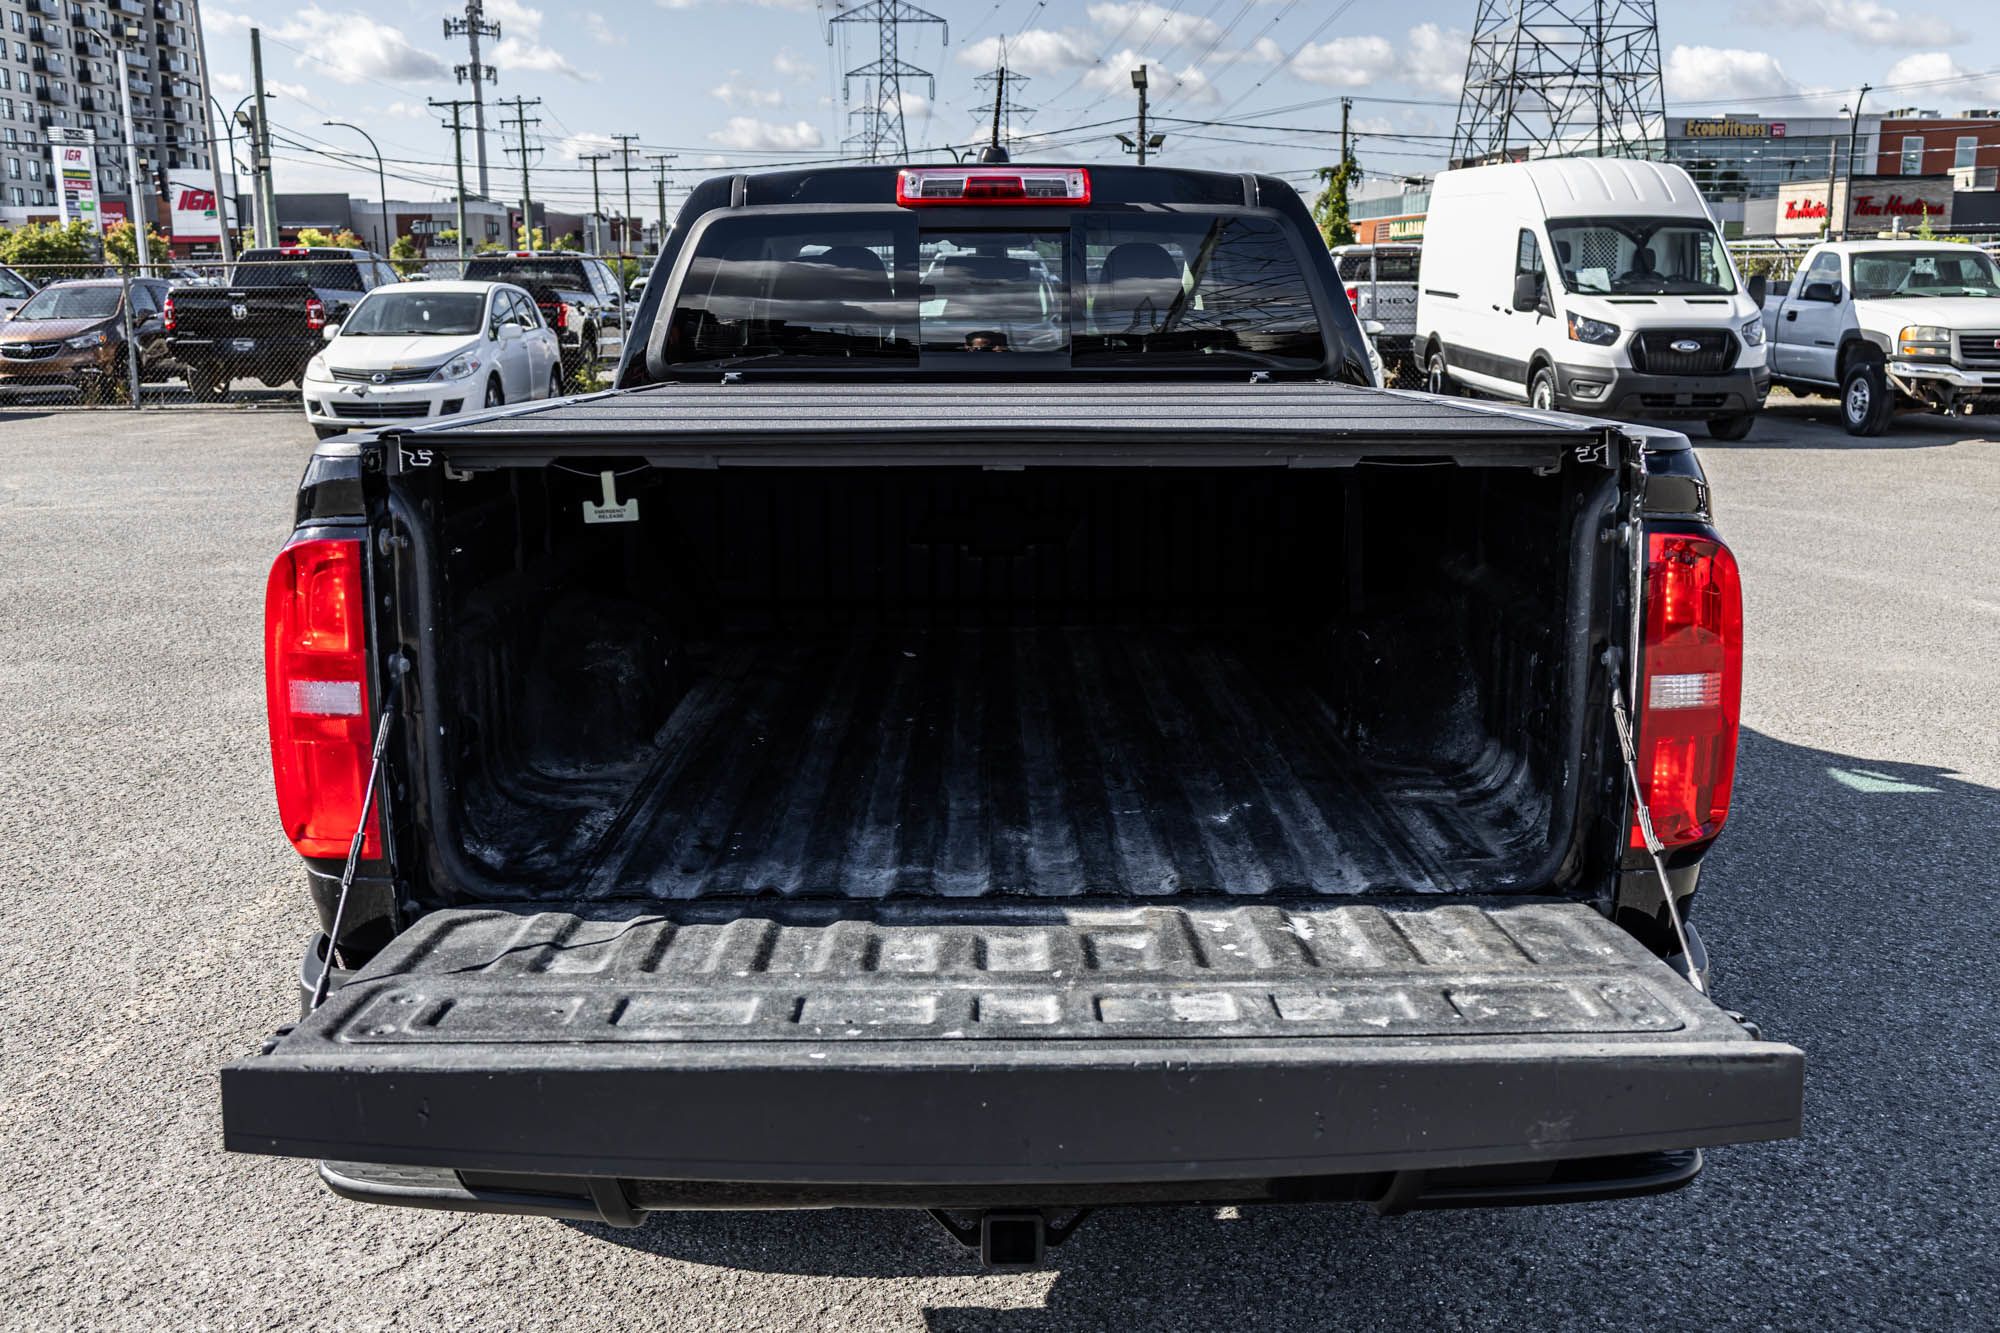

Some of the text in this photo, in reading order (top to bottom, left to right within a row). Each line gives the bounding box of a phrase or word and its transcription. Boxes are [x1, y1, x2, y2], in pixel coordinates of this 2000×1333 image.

[1686, 119, 1766, 136] Econofitness
[64, 149, 82, 161] IGA
[178, 190, 216, 211] IGA
[1785, 200, 1800, 219] Tim
[1854, 194, 1945, 216] Tim Hortons
[1389, 220, 1425, 237] DOLLARAM
